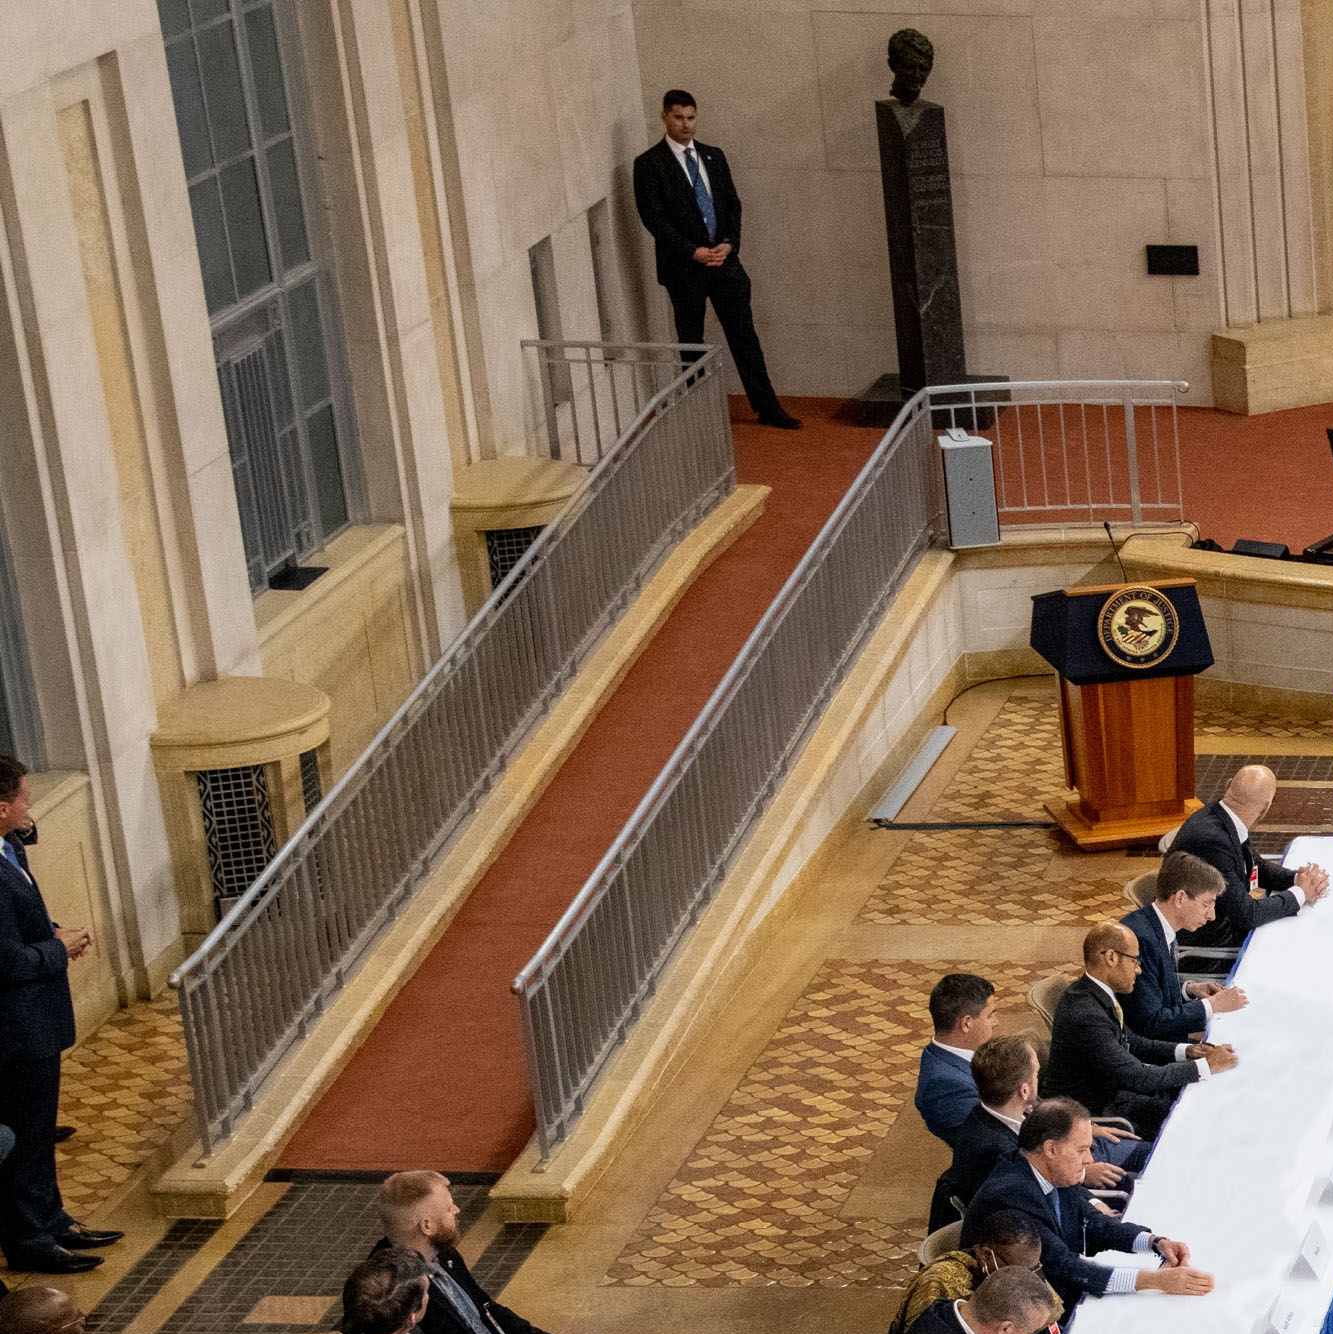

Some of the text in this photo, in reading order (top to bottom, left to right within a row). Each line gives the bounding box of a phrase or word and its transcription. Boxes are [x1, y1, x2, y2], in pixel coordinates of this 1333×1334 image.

[1103, 592, 1137, 642] DEPARTMENT
[1139, 592, 1153, 601] OF
[1153, 596, 1174, 633] JUSTICE
